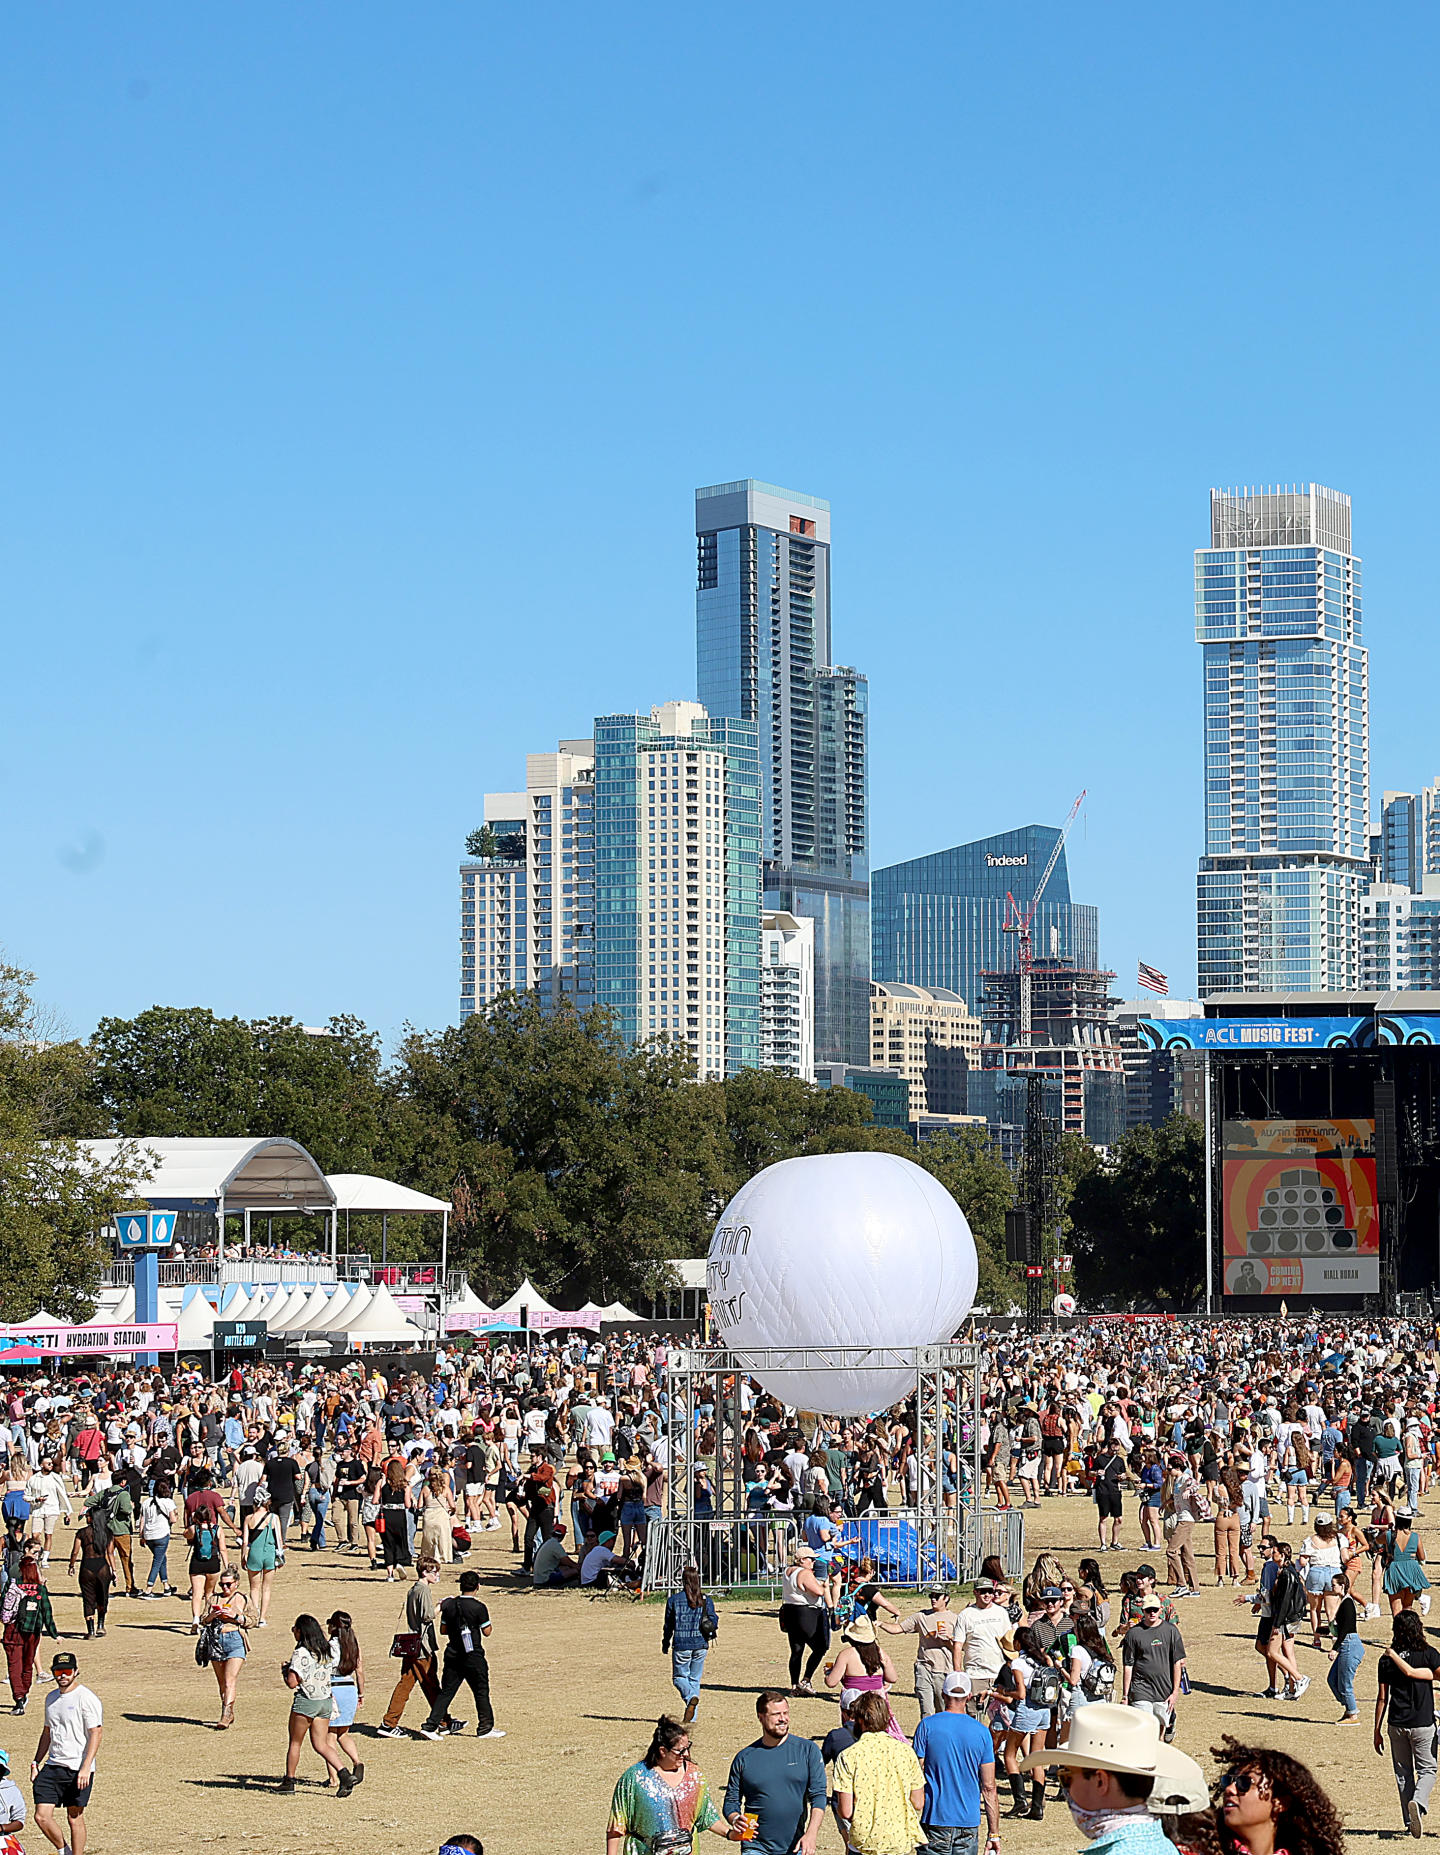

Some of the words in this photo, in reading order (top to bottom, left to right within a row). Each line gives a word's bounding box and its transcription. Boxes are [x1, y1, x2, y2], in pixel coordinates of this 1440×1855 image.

[985, 853, 1028, 866] indeed
[1205, 1028, 1239, 1043] ACL
[1241, 1027, 1281, 1042] MUSIC
[1284, 1027, 1314, 1042] FEST
[1261, 1128, 1291, 1136] AUSTIN
[1292, 1128, 1311, 1136] CITY
[1313, 1127, 1339, 1136] LIMITS
[1270, 1265, 1301, 1276] COMING
[1323, 1269, 1339, 1280] NIALL
[1270, 1276, 1281, 1287] UP
[1282, 1276, 1301, 1287] NEXT
[66, 1332, 108, 1348] HYDRATION
[113, 1331, 146, 1346] STATION
[224, 1335, 242, 1347] BOTTLE
[243, 1335, 257, 1346] SHOP
[535, 1419, 544, 1428] 21
